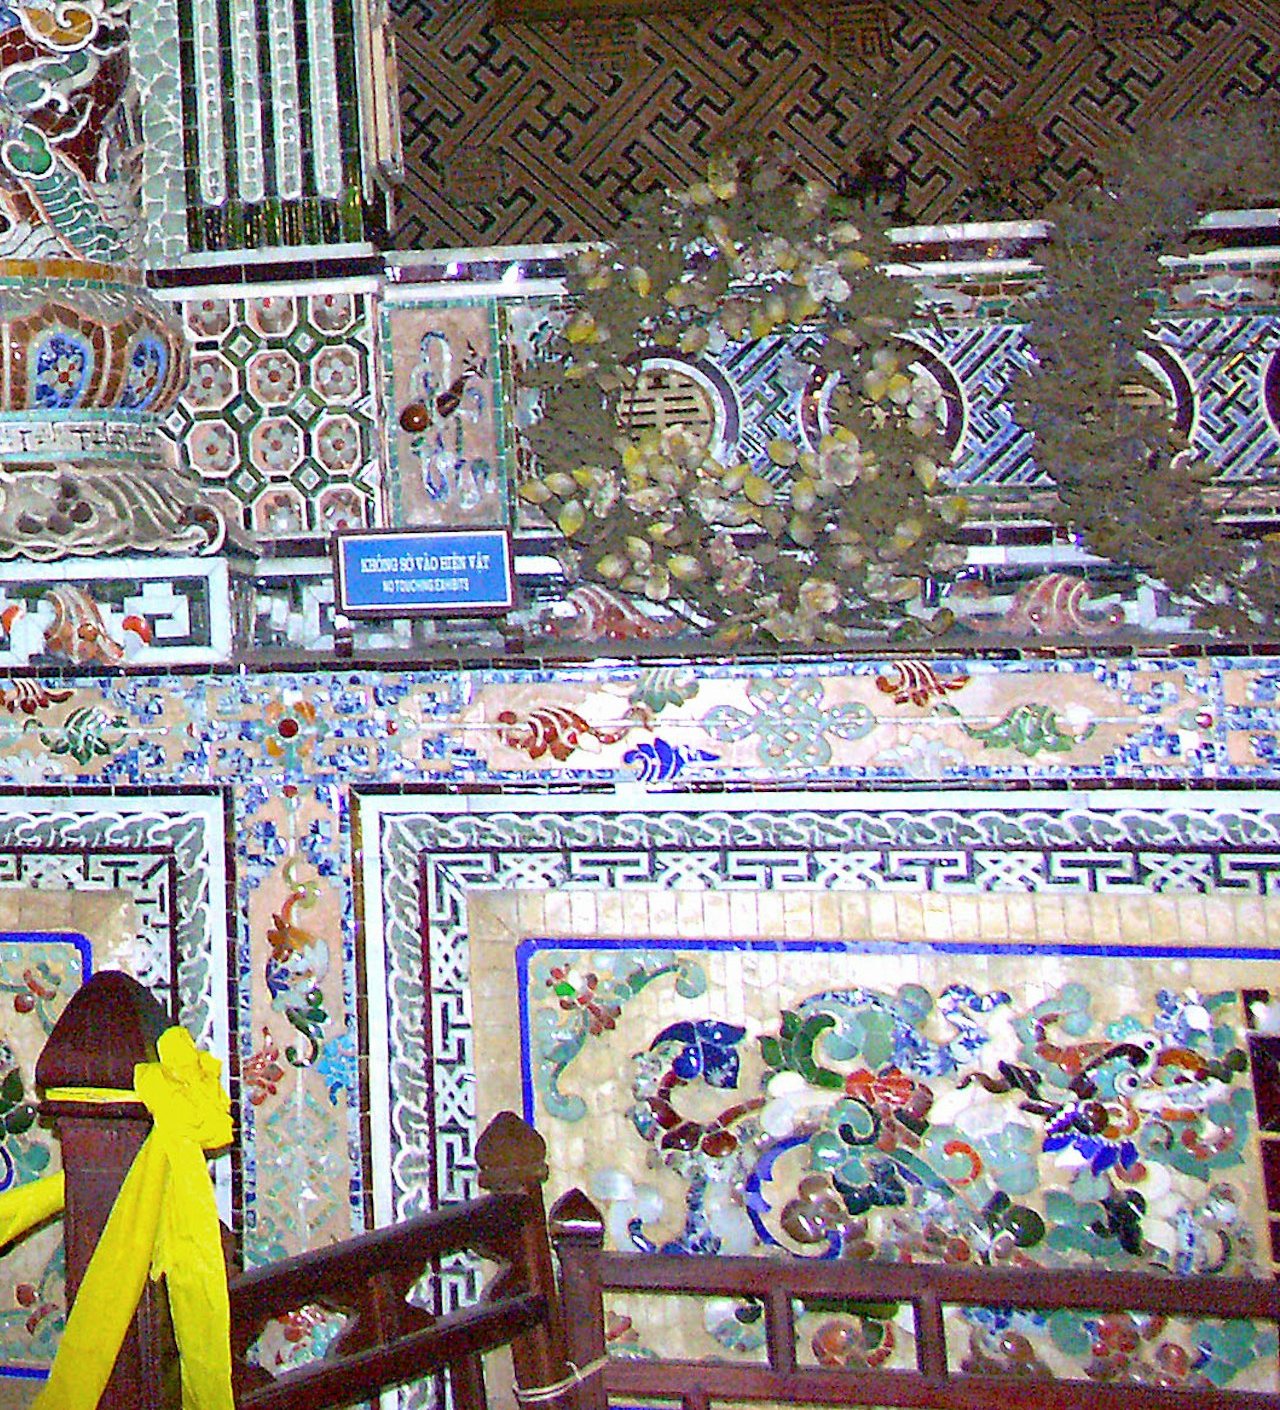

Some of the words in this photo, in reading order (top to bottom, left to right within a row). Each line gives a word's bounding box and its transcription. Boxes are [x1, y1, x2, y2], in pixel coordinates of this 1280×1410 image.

[360, 553, 398, 573] KHÔNG
[415, 552, 439, 572] VÀO
[382, 579, 394, 592] NO
